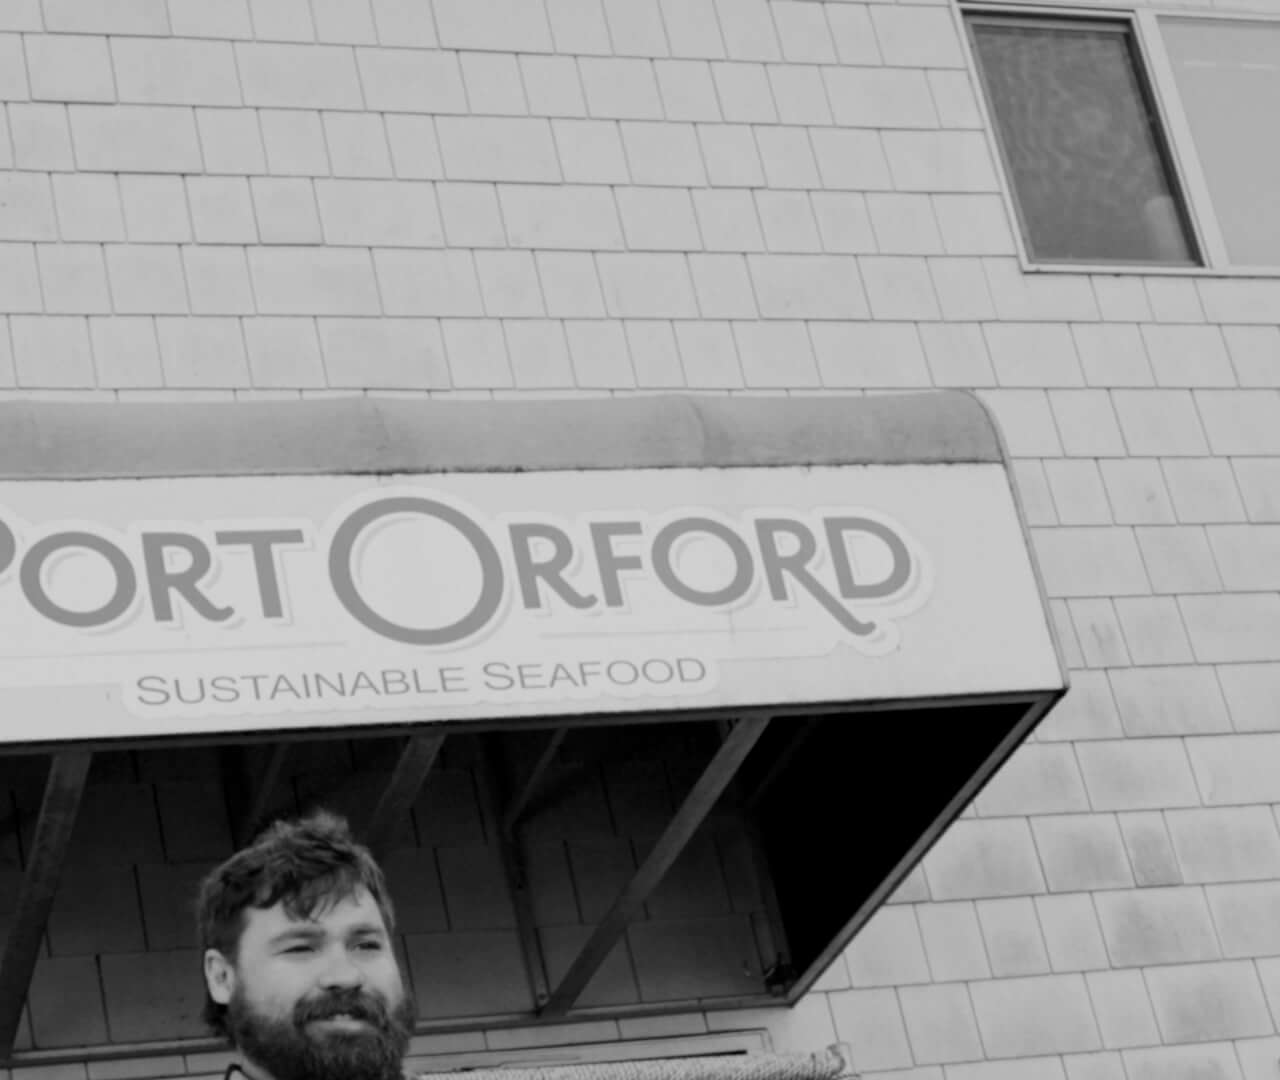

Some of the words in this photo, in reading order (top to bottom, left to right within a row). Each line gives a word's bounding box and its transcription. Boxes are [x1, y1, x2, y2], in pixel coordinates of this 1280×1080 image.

[329, 496, 912, 646] ORFORD
[136, 666, 469, 706] SUSTAINABLE
[483, 657, 707, 690] SEAFOOD
